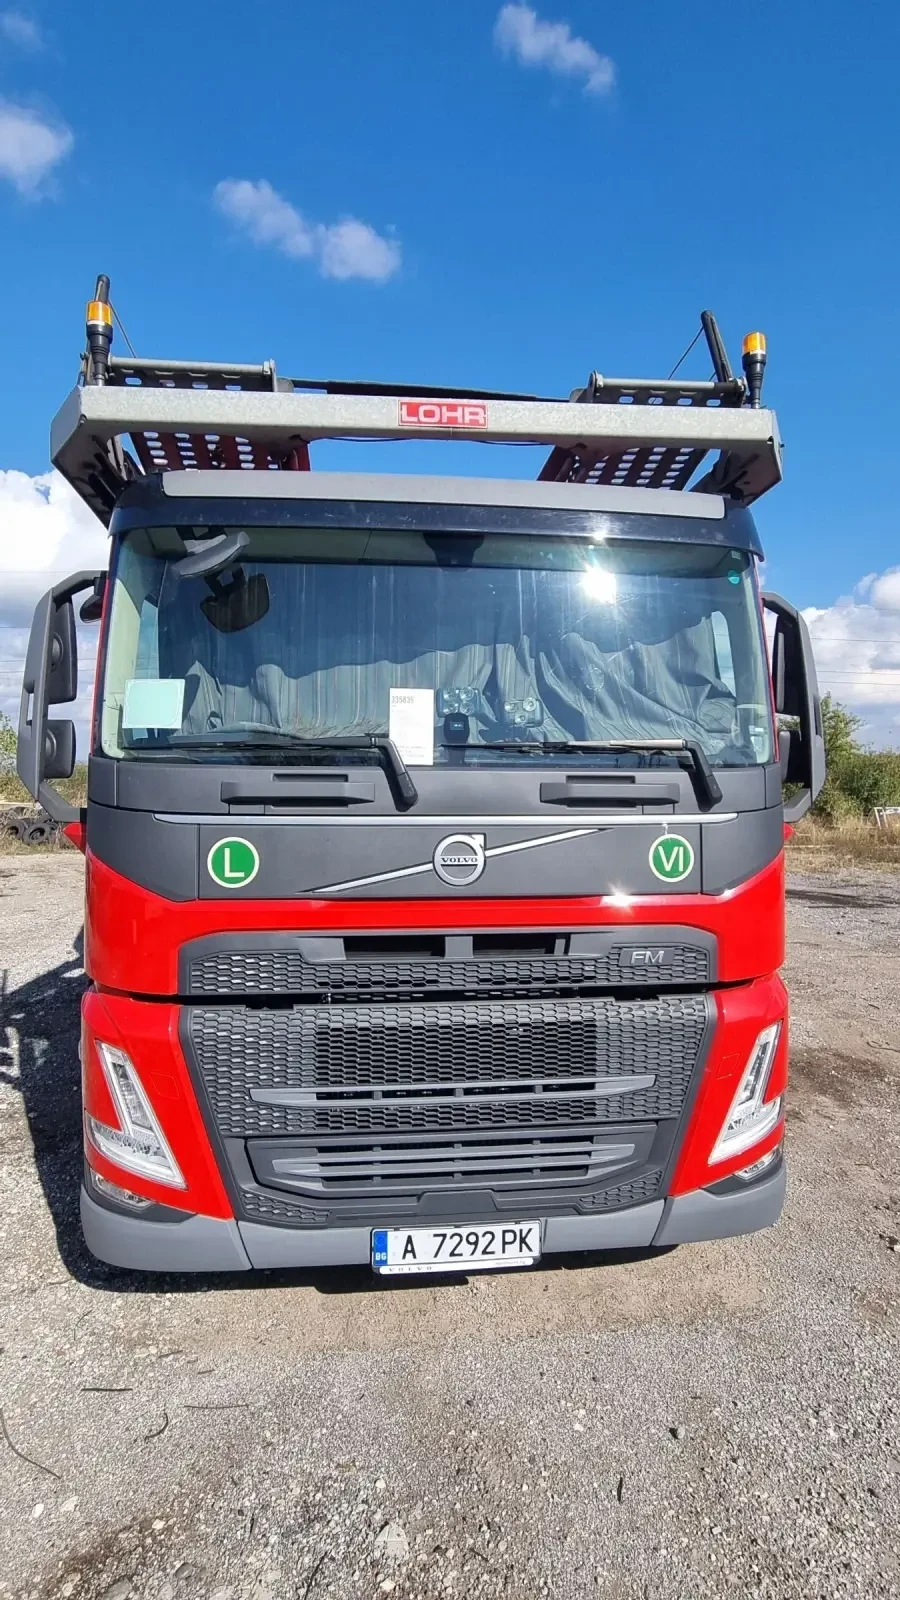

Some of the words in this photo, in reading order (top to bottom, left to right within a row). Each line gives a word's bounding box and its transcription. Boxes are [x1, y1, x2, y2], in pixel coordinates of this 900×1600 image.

[401, 404, 485, 425] LOHR
[224, 847, 245, 878] L
[657, 845, 684, 872] VI
[630, 950, 665, 964] FM
[375, 1252, 387, 1261] BG
[402, 1234, 417, 1260] A
